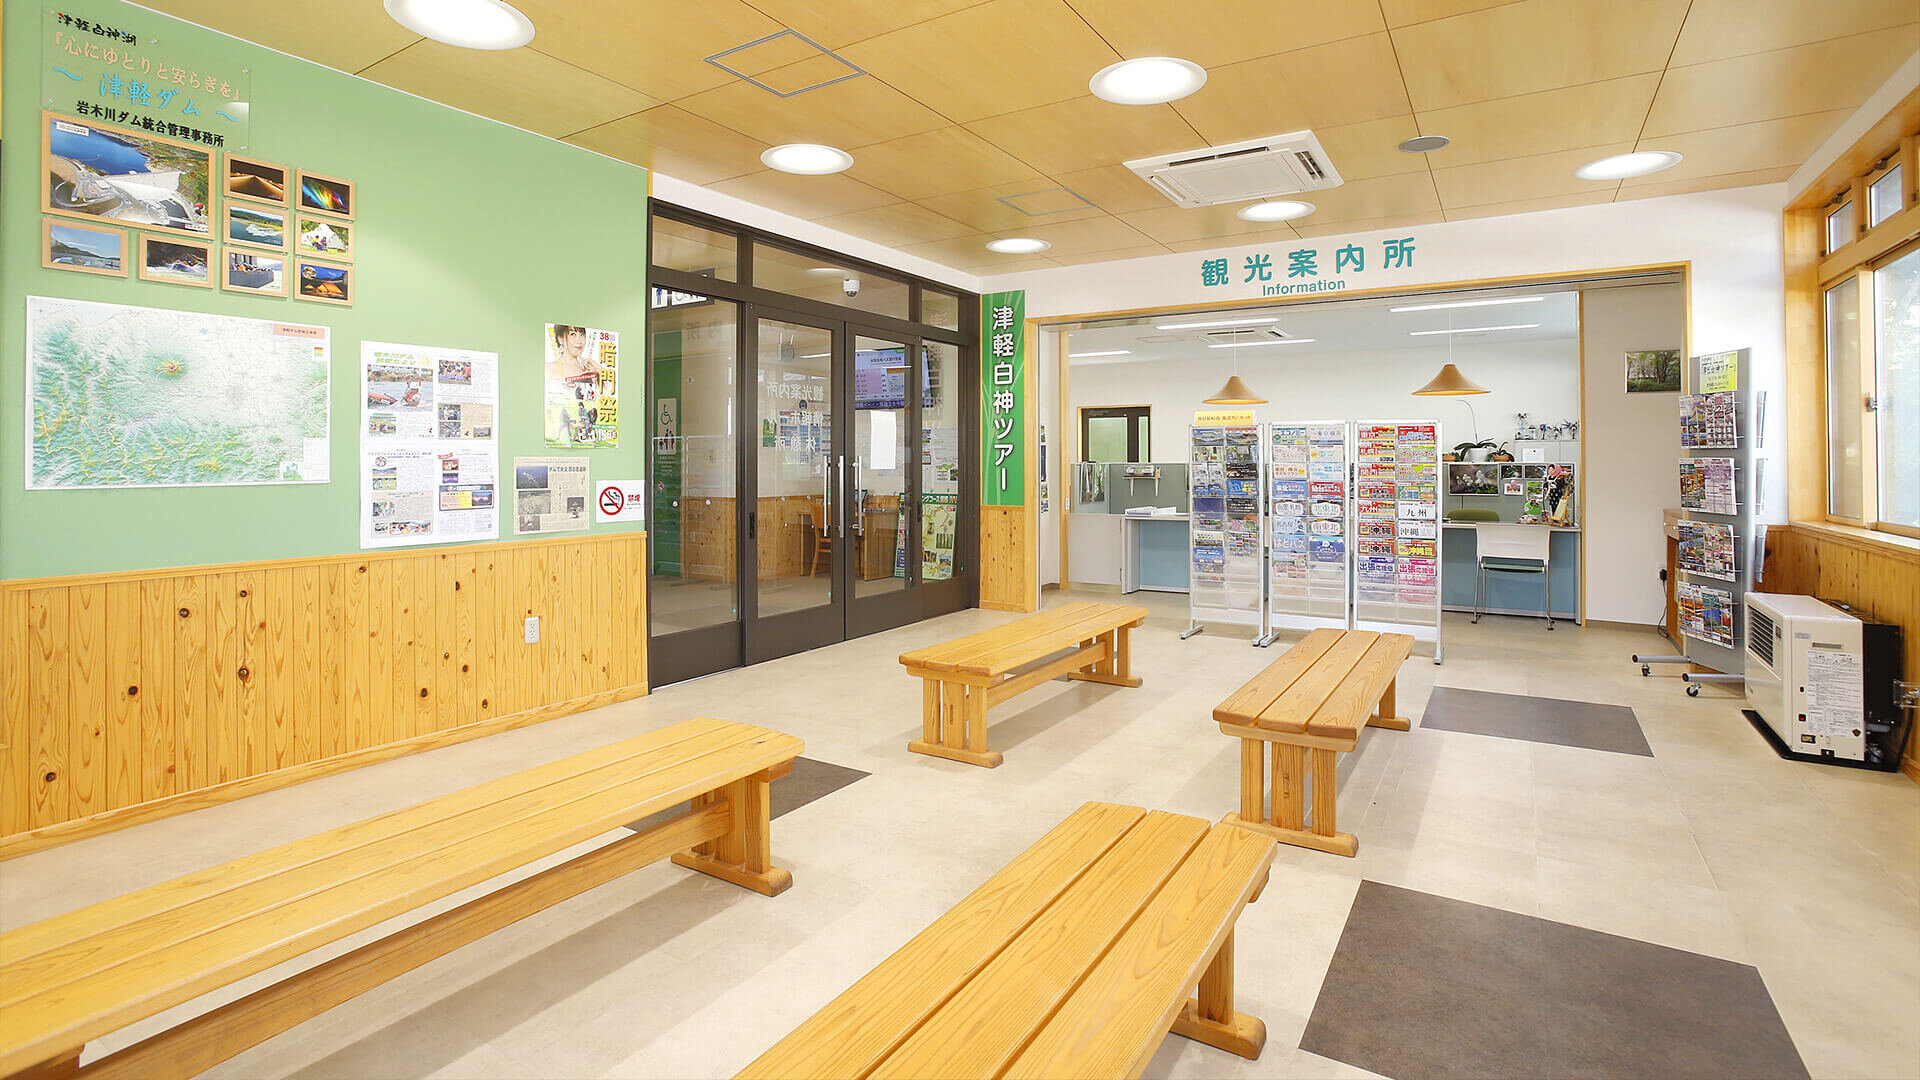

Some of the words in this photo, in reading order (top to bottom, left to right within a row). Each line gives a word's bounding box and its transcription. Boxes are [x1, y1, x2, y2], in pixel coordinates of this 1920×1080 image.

[58, 12, 137, 46] 津軽白神湖
[55, 31, 241, 101] 『心にゆとりと安らぎを』
[76, 100, 225, 148] 岩木川ダム統合管理事務所
[1201, 237, 1416, 287] 観光案内所
[1262, 278, 1346, 296] Information
[600, 341, 616, 422] 暗門祭
[992, 305, 1014, 491] 津軽白神ツアー
[1400, 528, 1419, 536] 沖縄
[1406, 509, 1427, 517] 九州
[1273, 537, 1305, 549] はとバス
